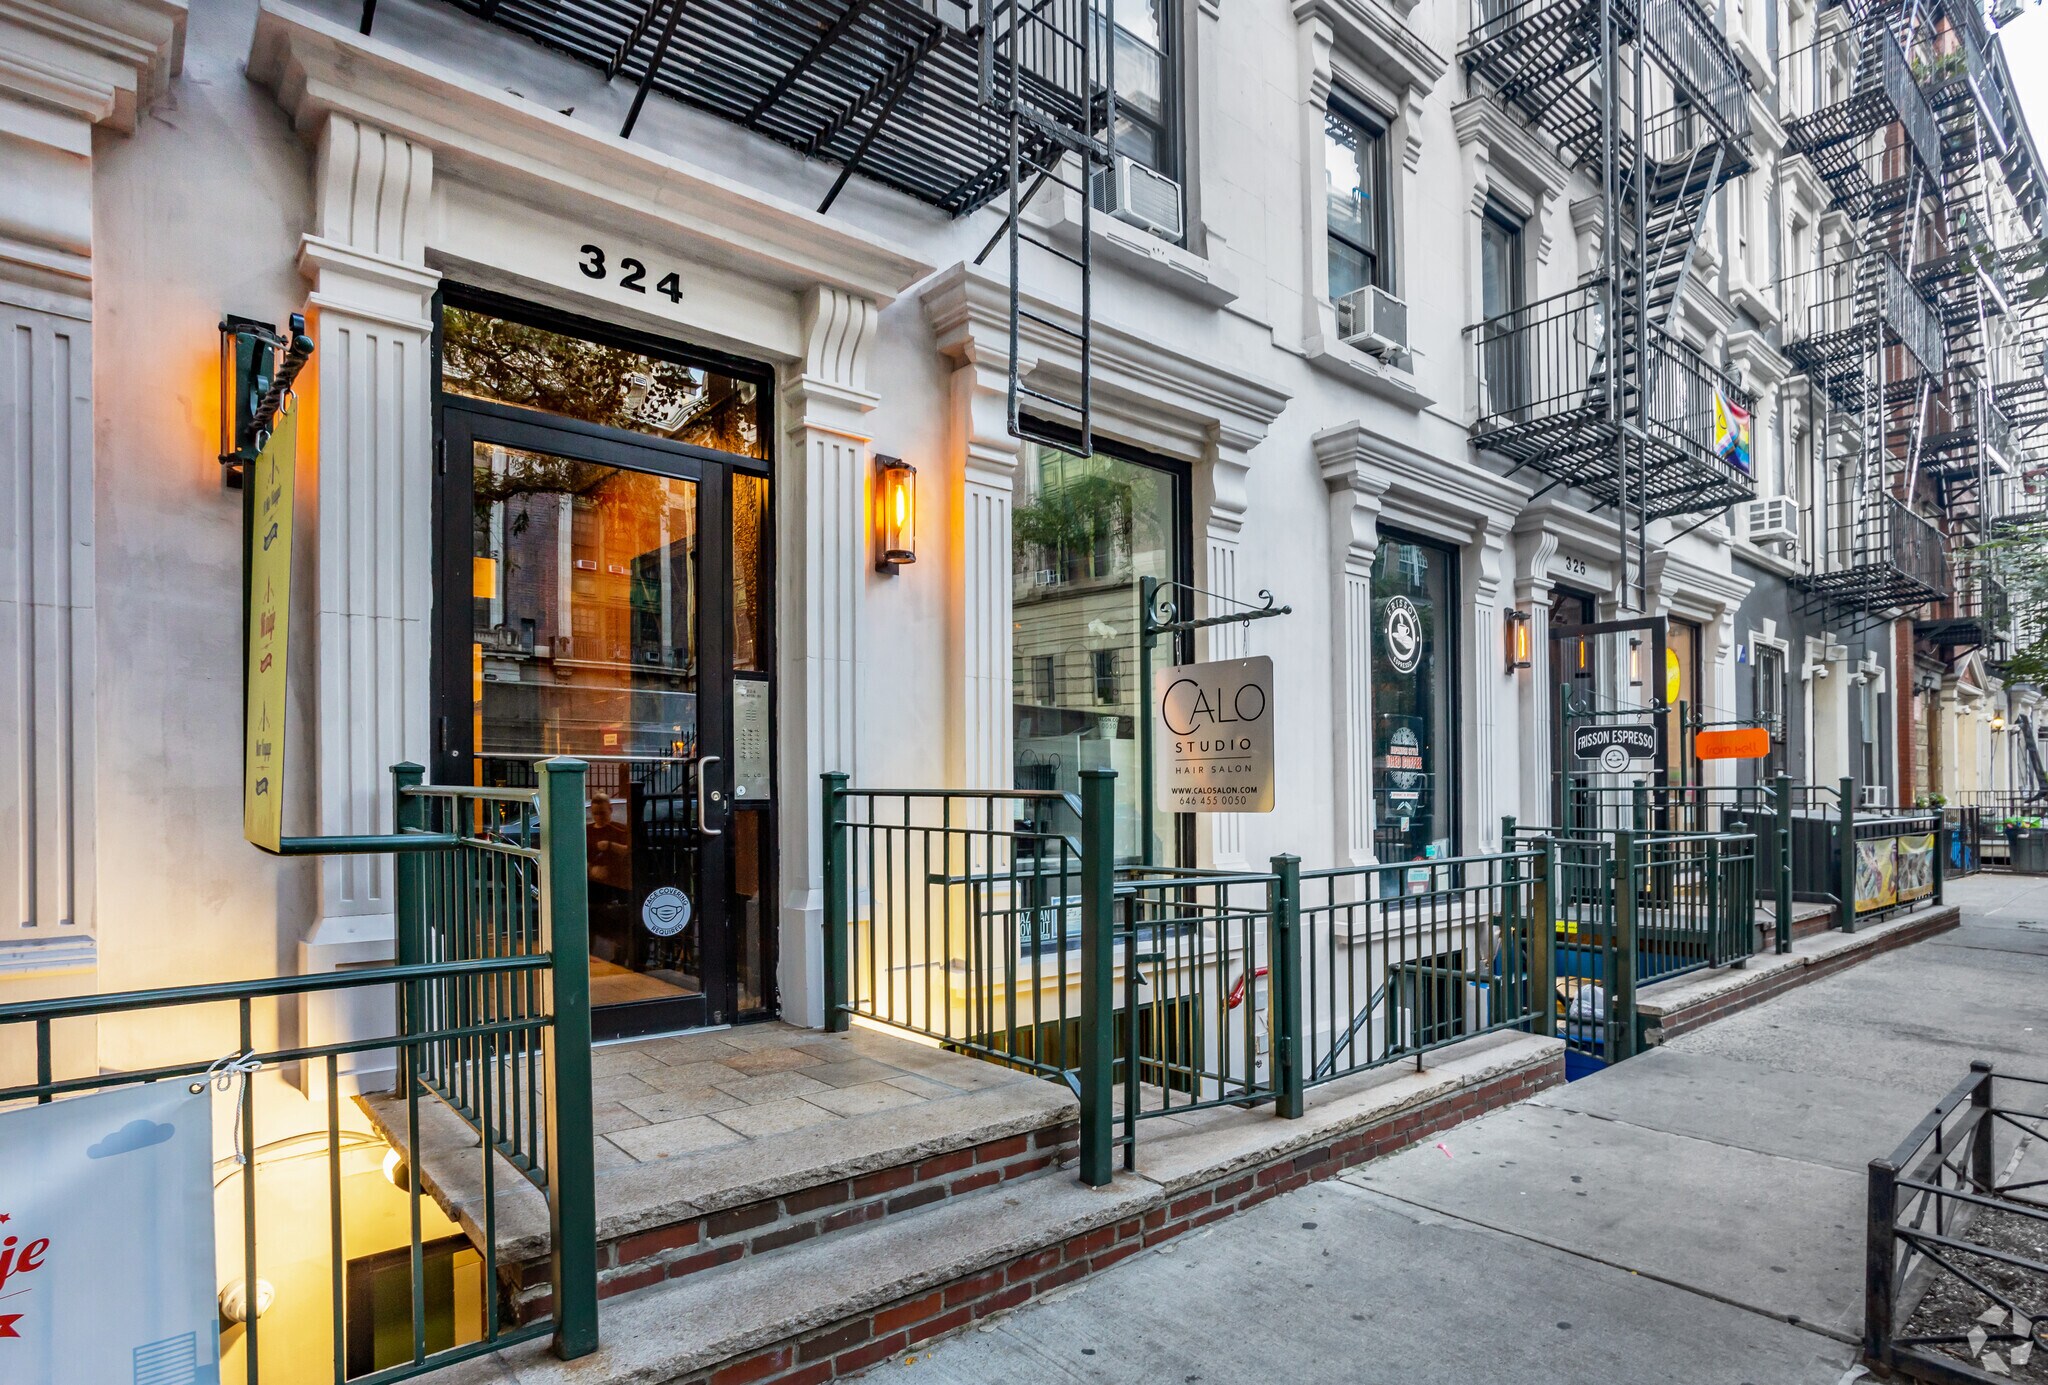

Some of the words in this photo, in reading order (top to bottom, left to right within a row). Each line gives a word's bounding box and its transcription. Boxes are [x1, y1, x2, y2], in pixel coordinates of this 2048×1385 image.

[578, 244, 683, 304] 324
[1565, 556, 1586, 576] 326
[1387, 599, 1417, 623] FRISSON
[1162, 678, 1266, 736] CALO
[1175, 738, 1252, 753] STUDIO
[1577, 733, 1610, 751] FRISSON
[1612, 730, 1654, 749] ESPRESSO
[1175, 765, 1205, 774] HAIR
[1211, 764, 1252, 774] SALON
[1171, 786, 1258, 795] WWW.CALOSALON.COM
[1179, 796, 1197, 805] 646
[1200, 796, 1218, 805] 455
[1221, 796, 1247, 805] 0050
[644, 892, 659, 907] FACE
[658, 887, 689, 906] COVERING
[651, 924, 683, 936] REQUIRED
